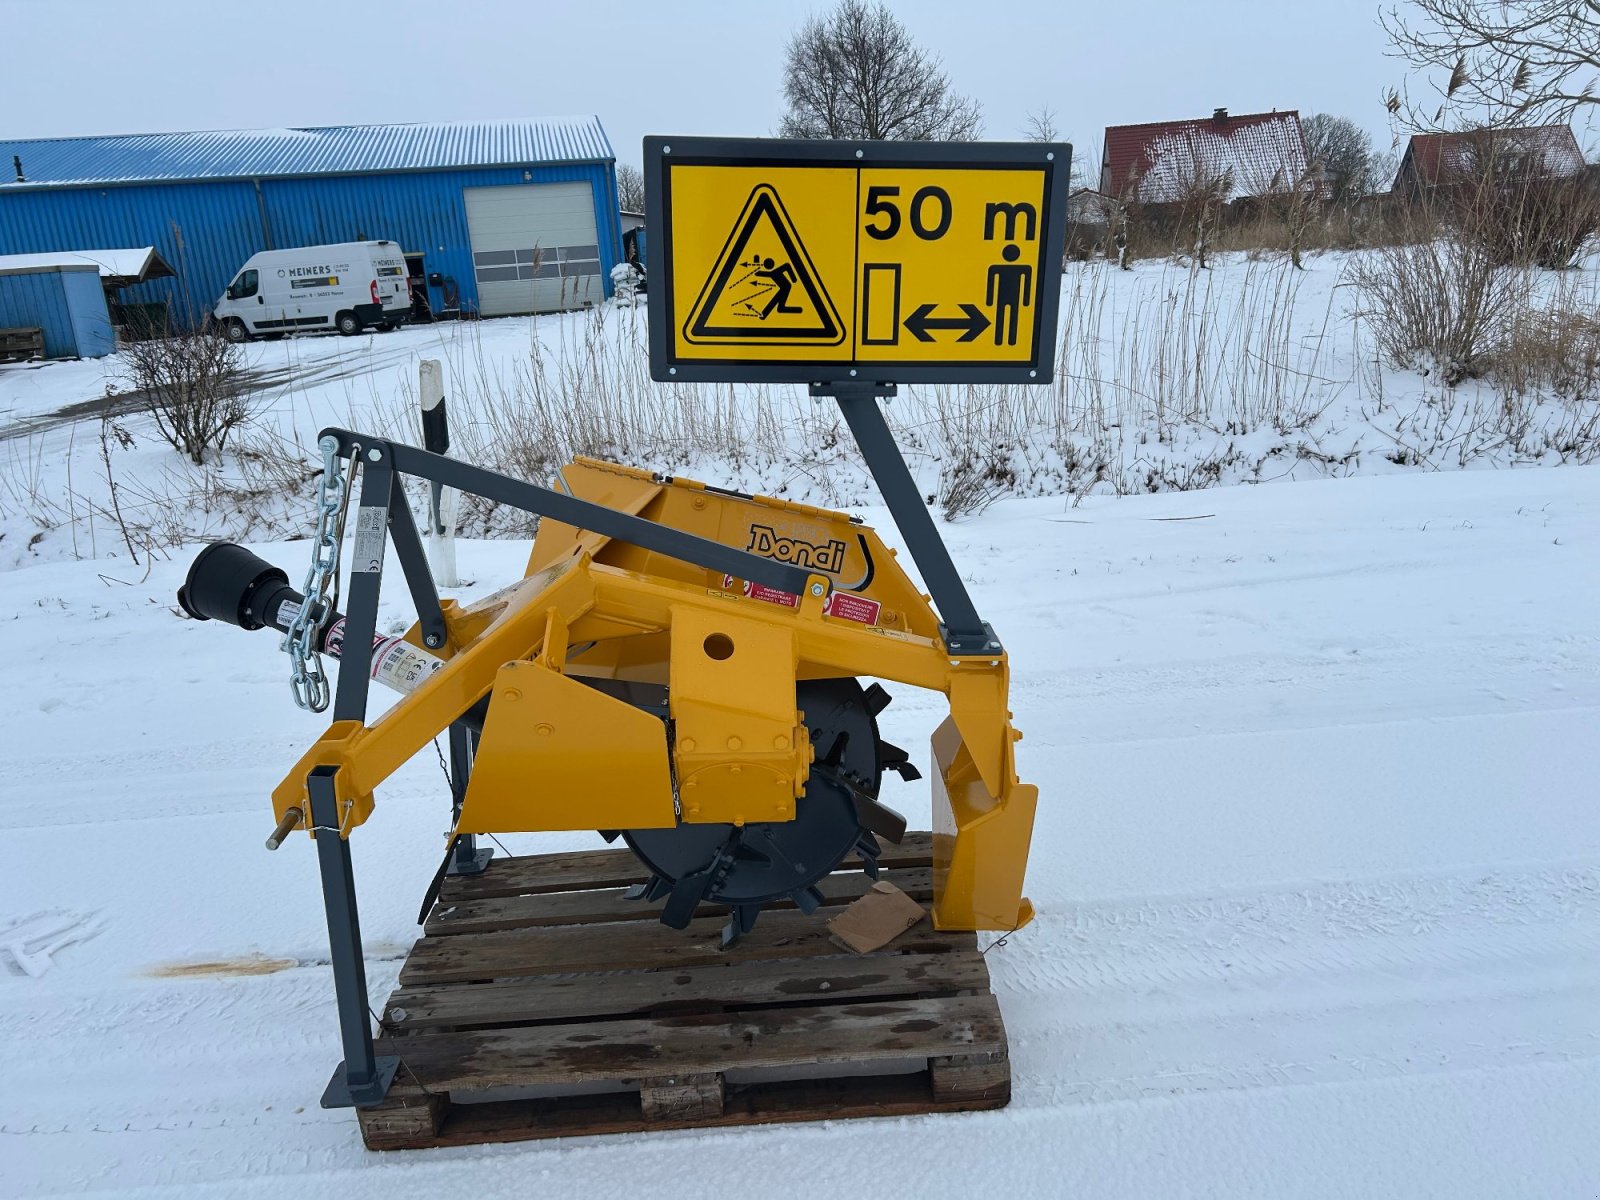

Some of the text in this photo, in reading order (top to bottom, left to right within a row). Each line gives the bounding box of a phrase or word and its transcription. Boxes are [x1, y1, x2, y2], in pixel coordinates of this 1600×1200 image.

[865, 186, 1036, 240] 50 m
[289, 265, 331, 276] MEINERS
[746, 524, 846, 573] Dondi
